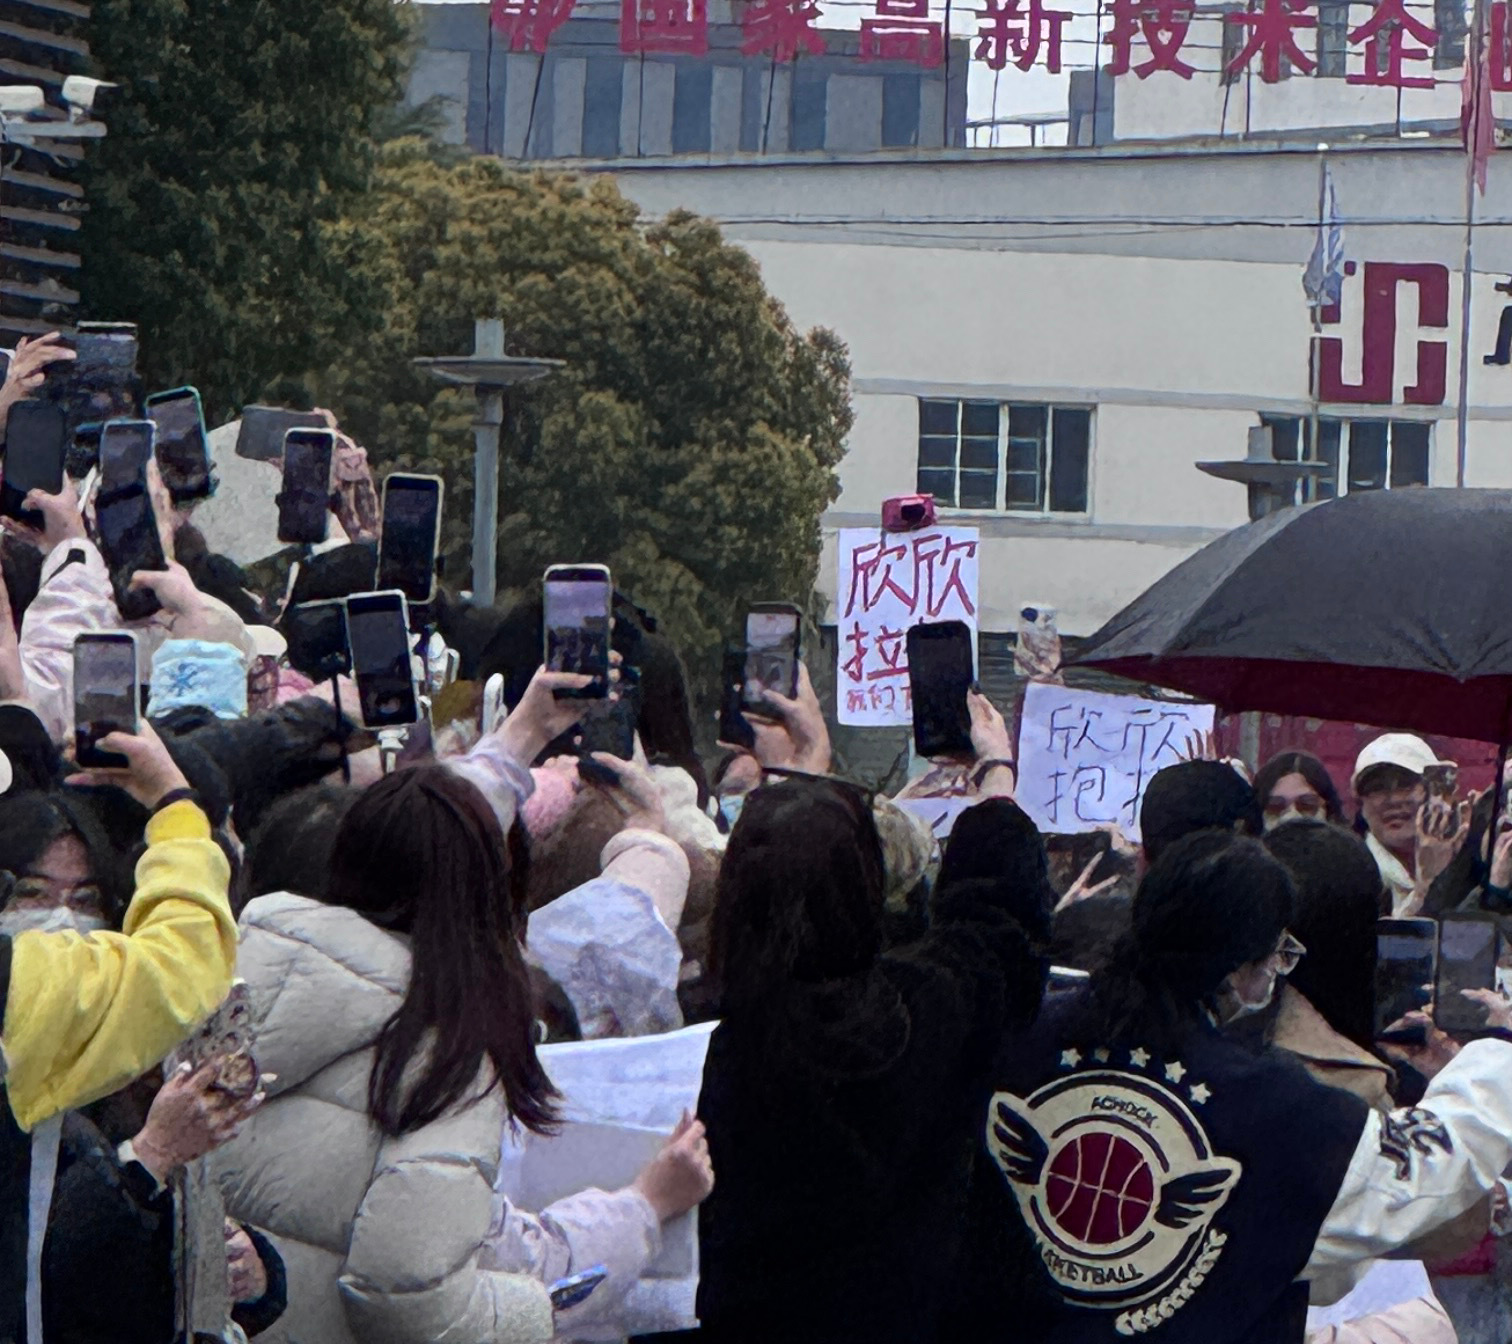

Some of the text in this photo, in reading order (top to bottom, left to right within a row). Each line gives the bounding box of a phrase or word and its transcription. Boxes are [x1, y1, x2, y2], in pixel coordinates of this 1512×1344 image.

[843, 533, 976, 617] 欣欣
[841, 616, 926, 683] 拉
[1046, 706, 1190, 760] 欣欣
